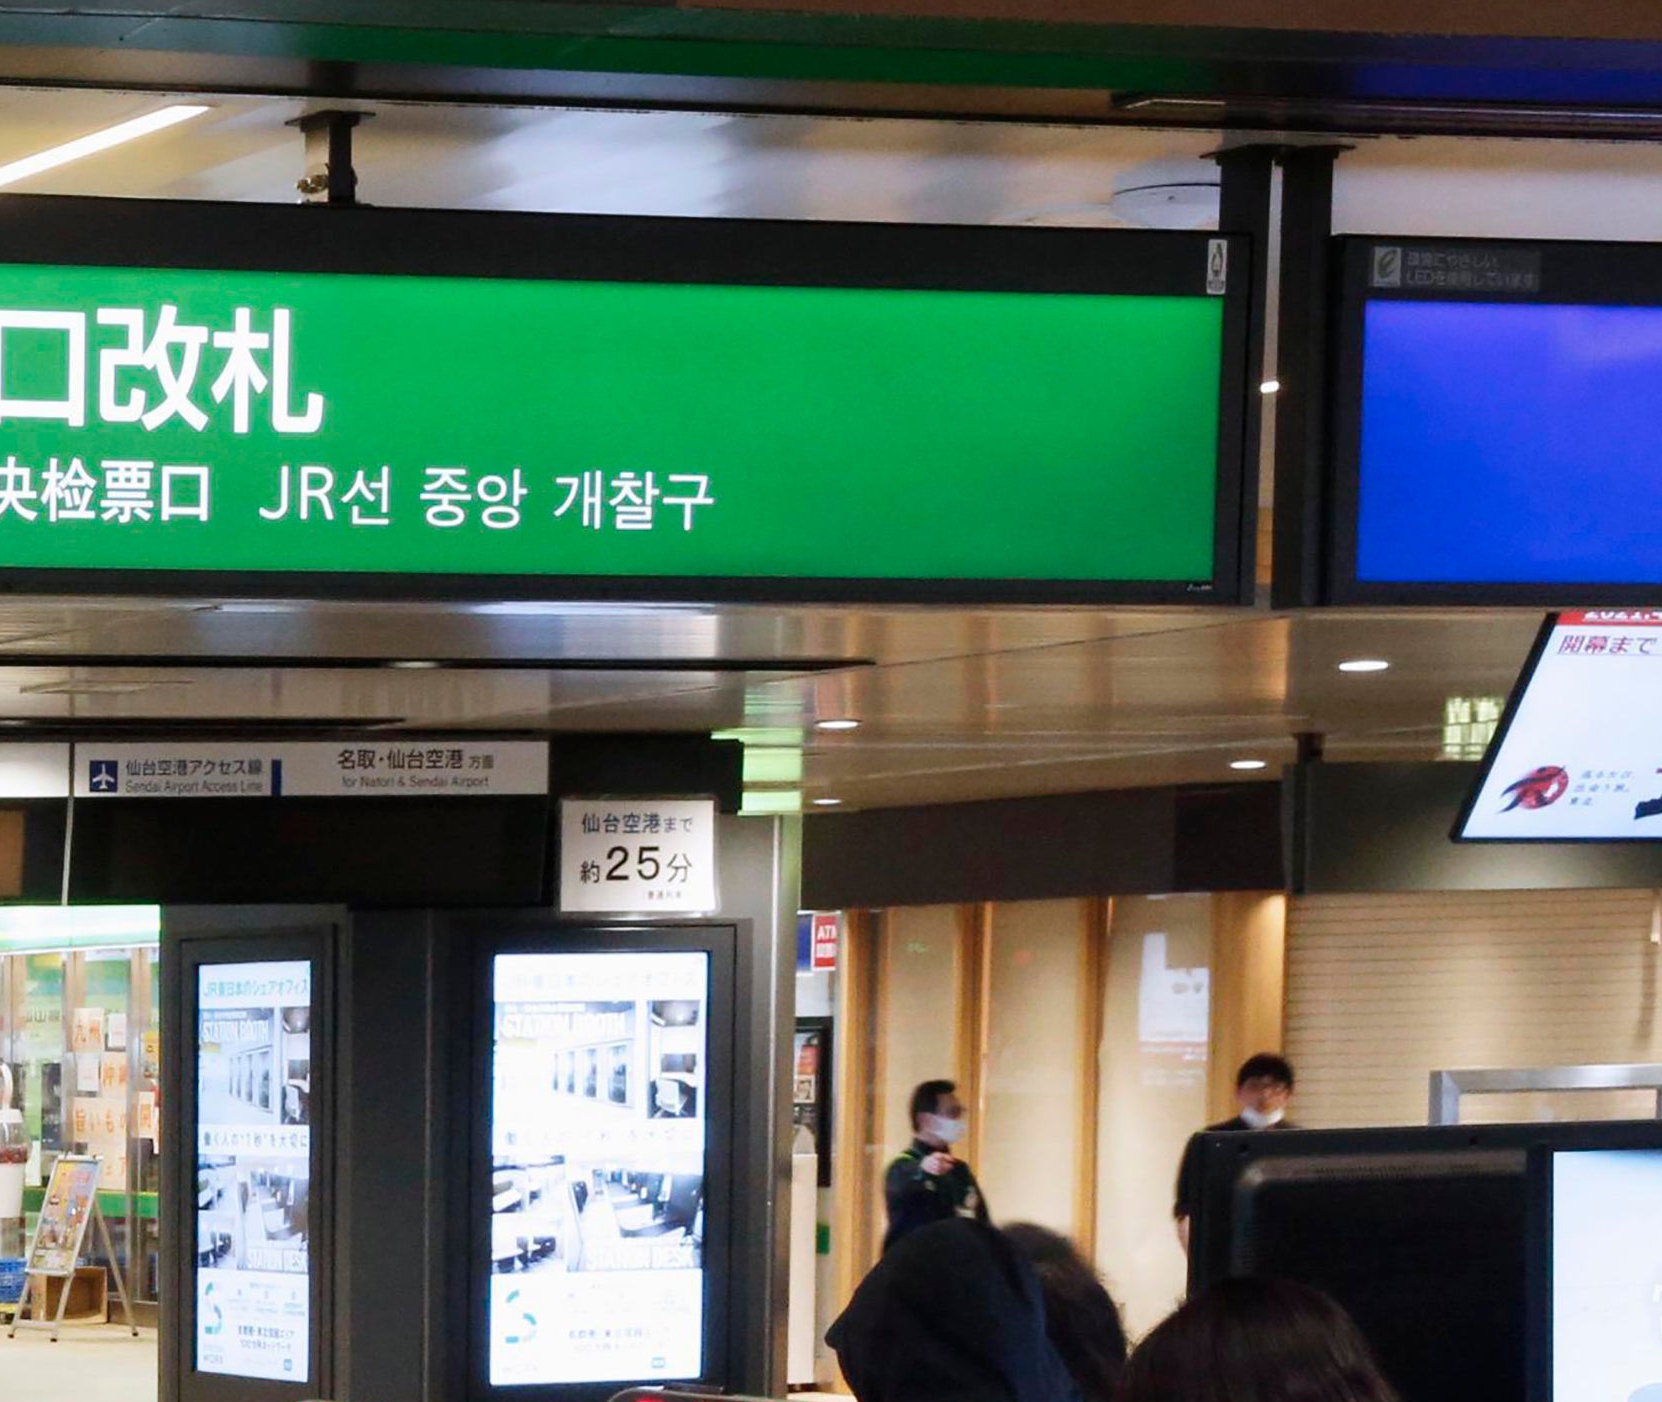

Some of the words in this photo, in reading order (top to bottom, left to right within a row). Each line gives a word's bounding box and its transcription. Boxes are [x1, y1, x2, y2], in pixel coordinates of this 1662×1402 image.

[259, 465, 390, 525] JR선
[419, 467, 528, 529] 중앙
[554, 470, 714, 531] 개찰구
[1558, 634, 1658, 656] 開幕まで
[126, 759, 263, 777] 仙台空港アクセス線
[337, 749, 464, 770] 名取・仙台空港
[468, 755, 495, 770] 方面
[126, 780, 161, 793] Sendai
[164, 780, 200, 795] Airport
[342, 775, 357, 788] for
[359, 775, 395, 788] Natori
[397, 776, 406, 788] &
[409, 775, 448, 788] Sendai
[451, 775, 490, 790] Airport
[581, 812, 694, 834] 仙台空港まで
[580, 846, 694, 884] 約25分
